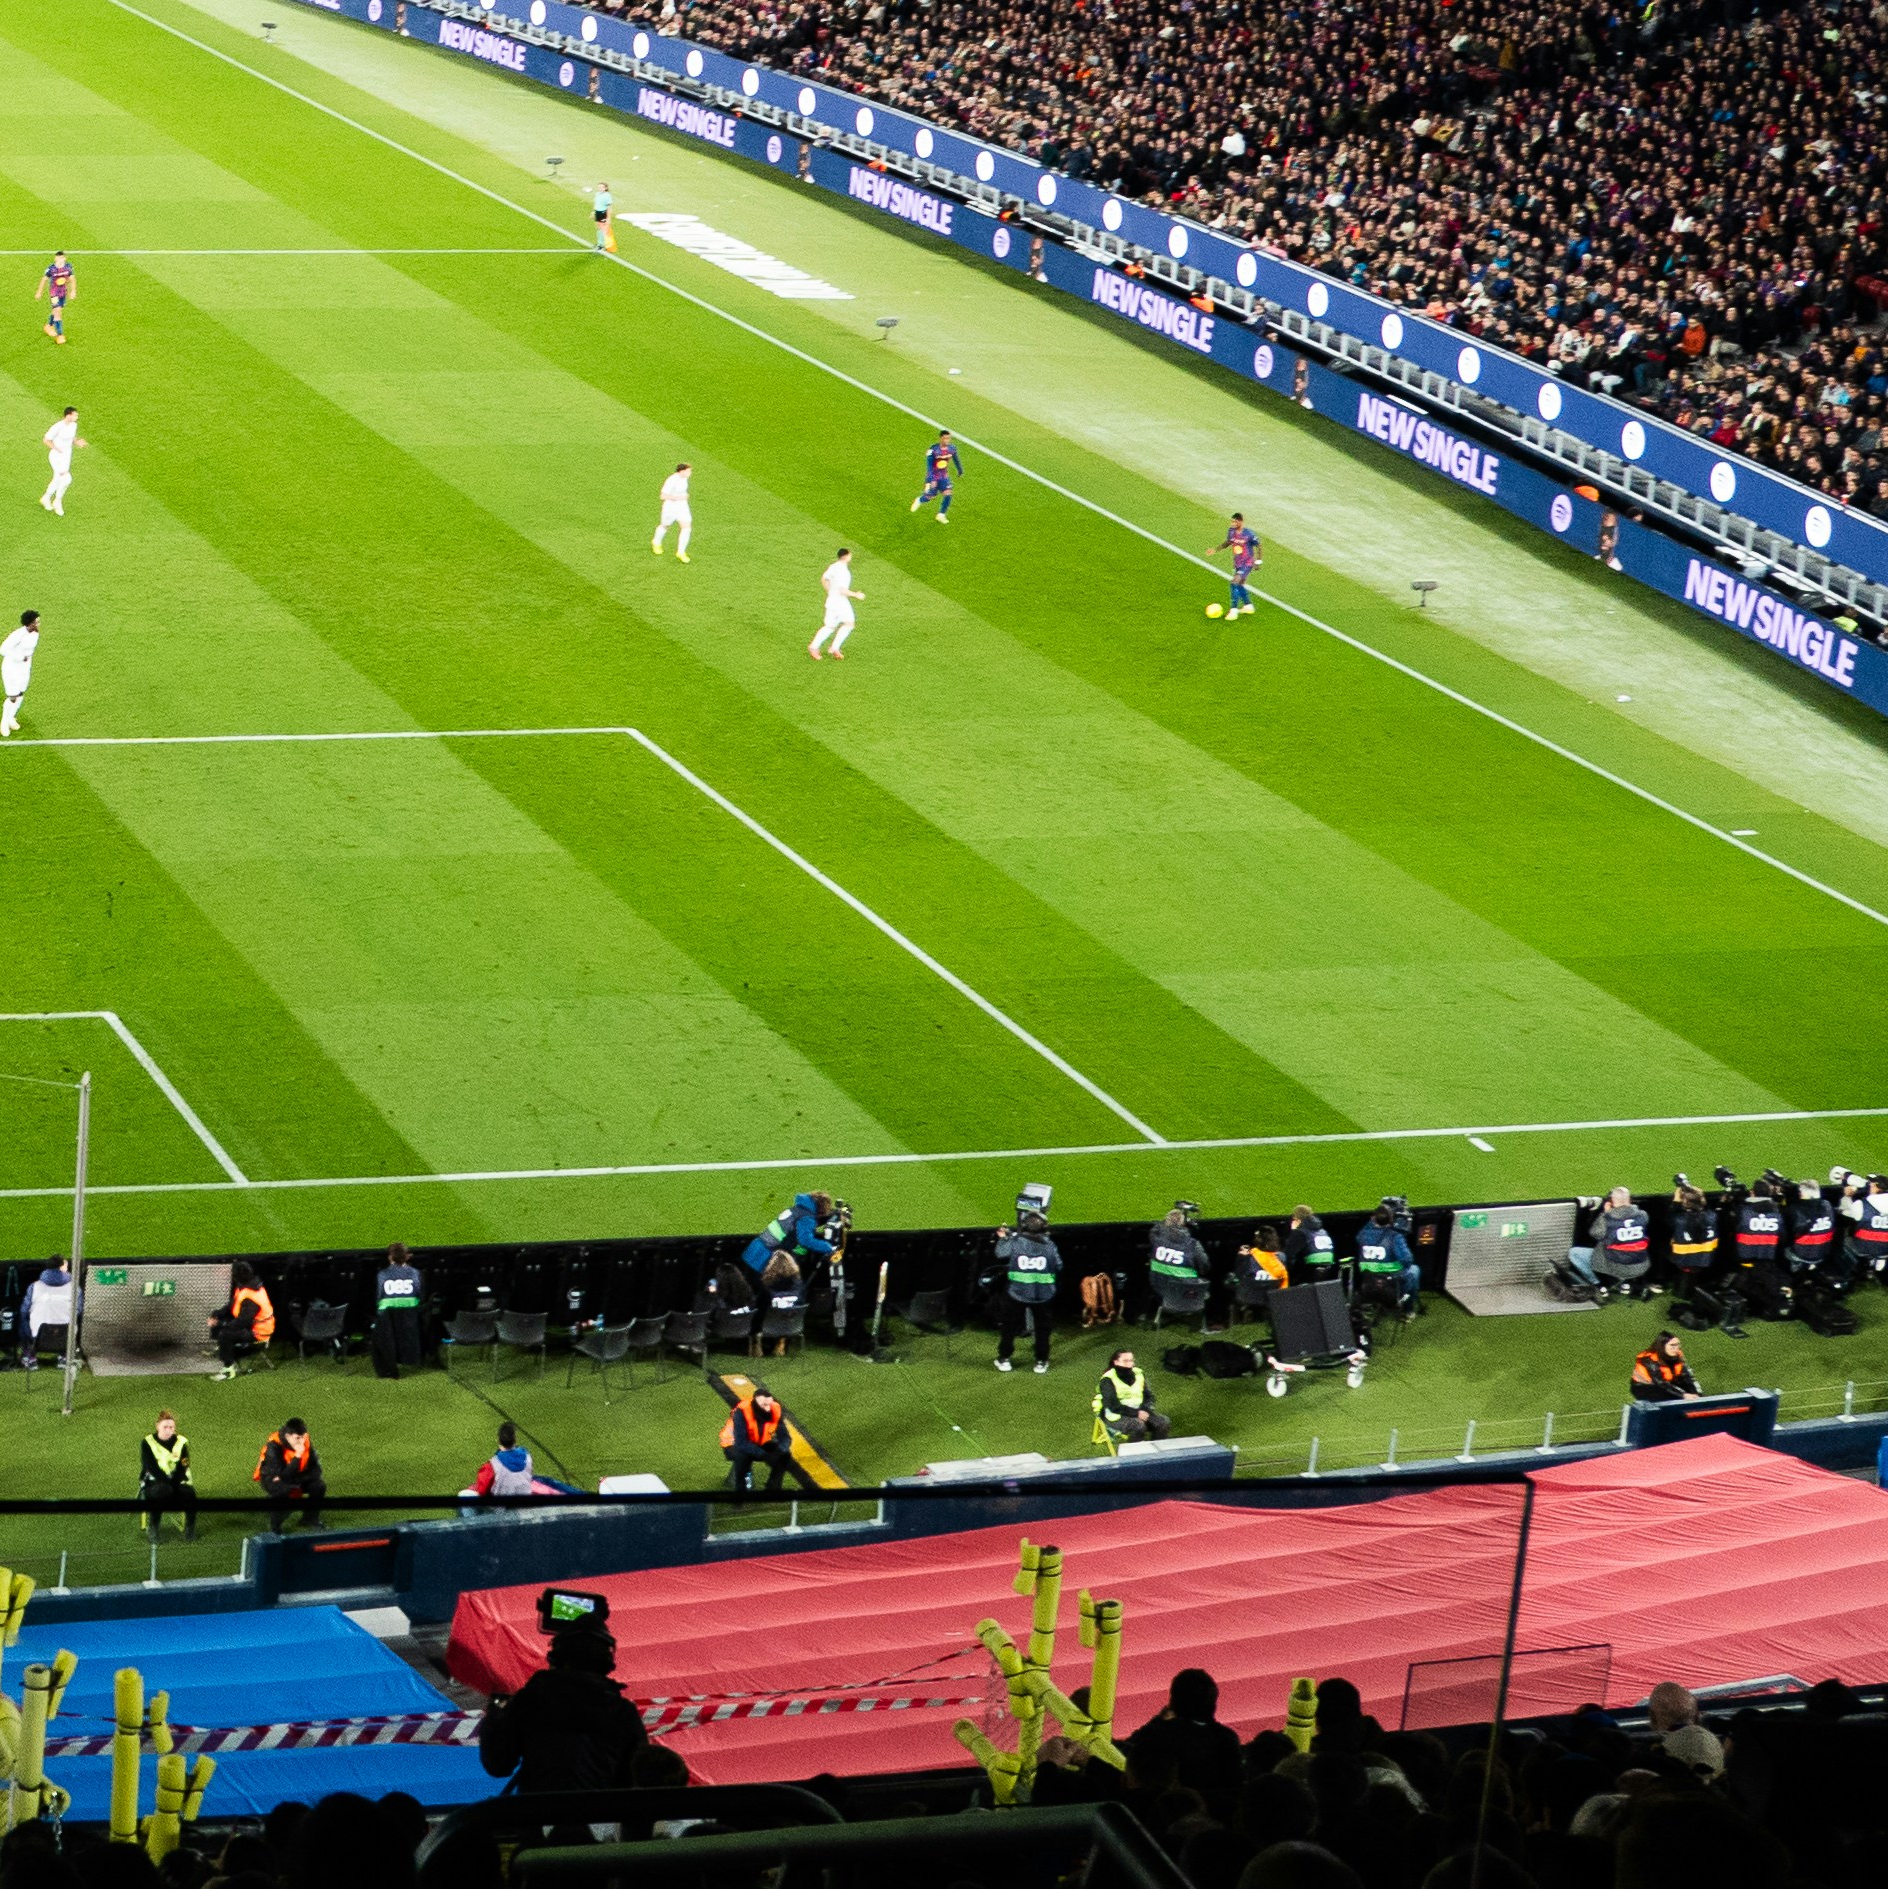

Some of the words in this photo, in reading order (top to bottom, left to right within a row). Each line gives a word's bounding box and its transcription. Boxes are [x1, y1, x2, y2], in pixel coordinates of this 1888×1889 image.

[438, 19, 476, 53] NEW
[473, 30, 526, 72] SINGLE
[637, 87, 679, 126] NEW
[675, 101, 737, 148] SINGLE
[849, 166, 898, 210] NEW
[889, 183, 953, 236] SINGLE
[1092, 268, 1142, 318] NEW
[1139, 290, 1215, 354] SINGLE
[1357, 392, 1415, 451] NEW
[1412, 420, 1499, 496] SINGLE
[1684, 559, 1759, 628] NEW
[1753, 595, 1858, 687] SINGLE
[1155, 1246, 1185, 1265] 075
